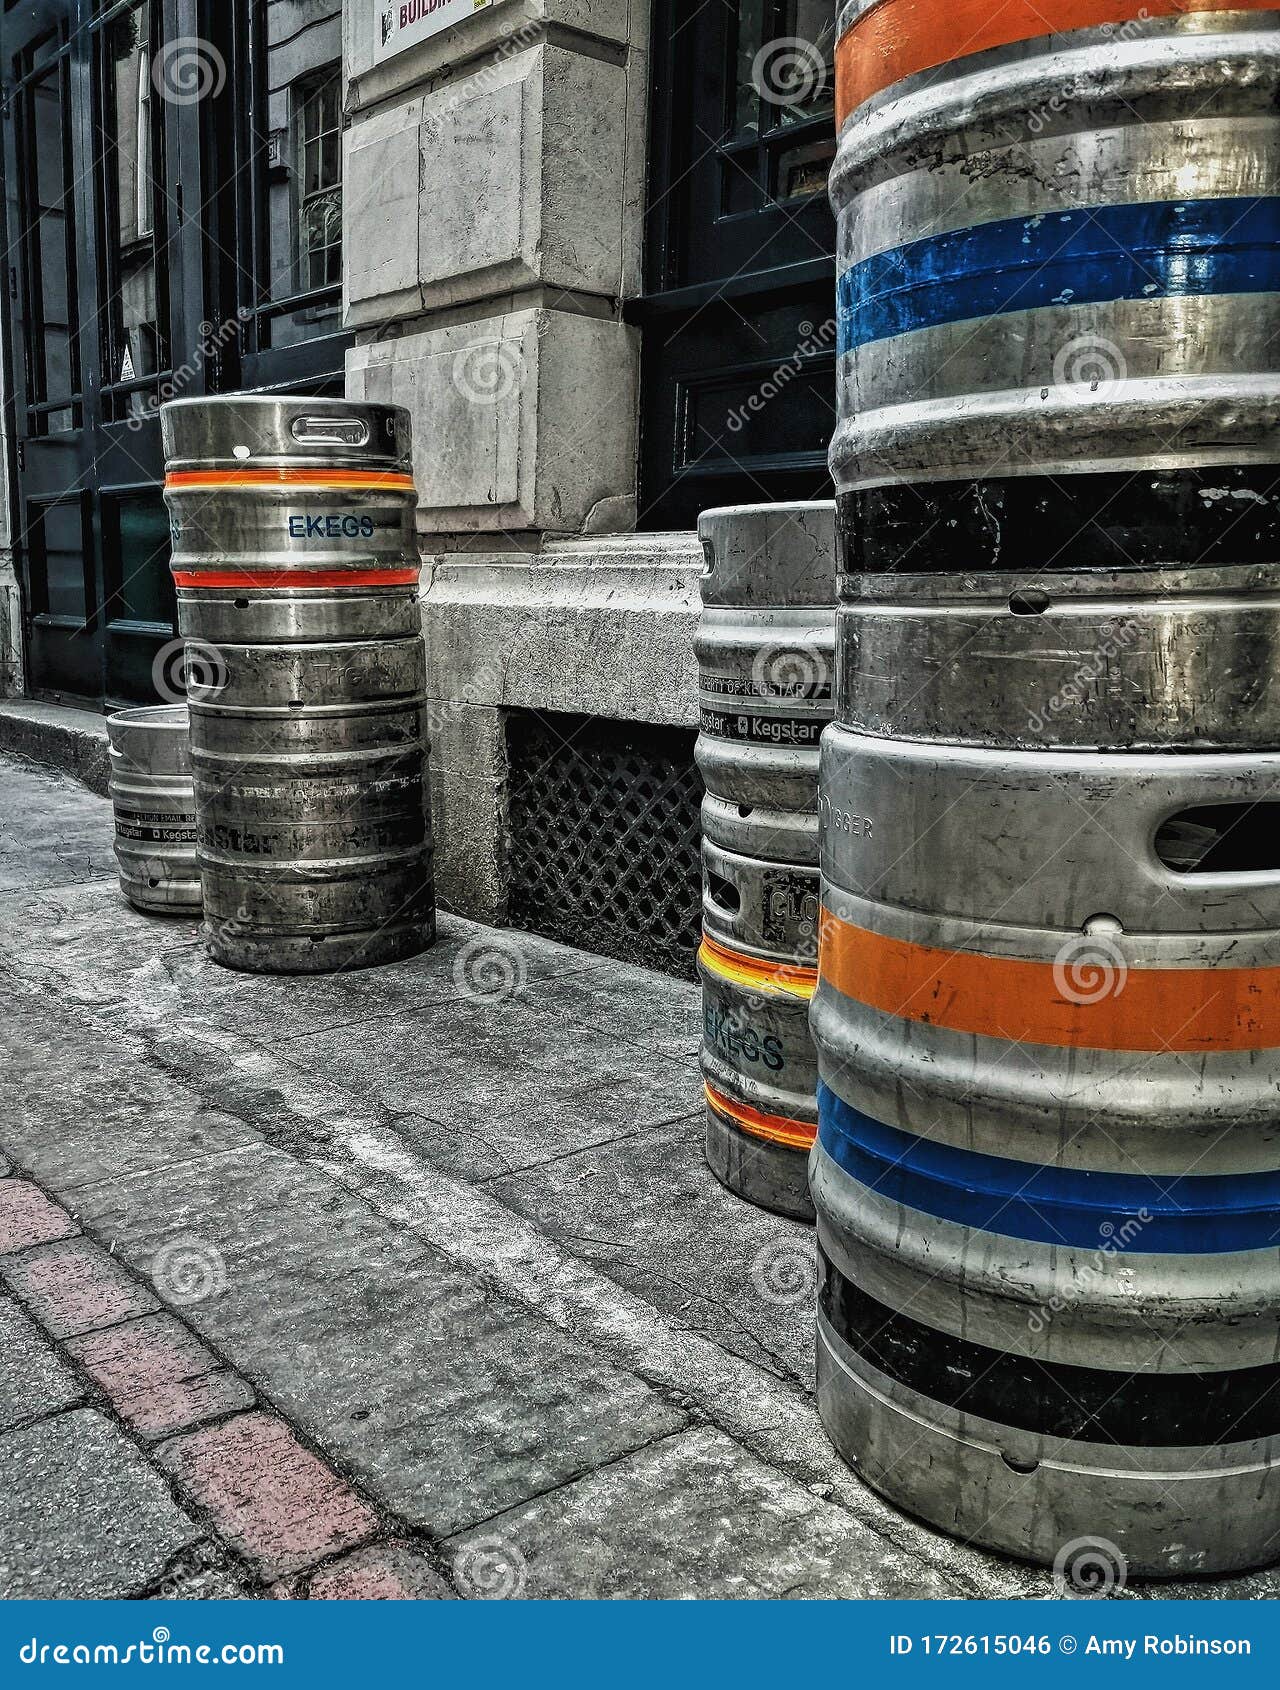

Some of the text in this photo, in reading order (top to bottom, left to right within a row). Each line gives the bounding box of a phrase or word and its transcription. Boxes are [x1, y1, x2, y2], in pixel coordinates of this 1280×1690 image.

[289, 515, 374, 538] EKEGS
[744, 679, 806, 698] KEGSTAR
[752, 716, 819, 741] Kegstar
[162, 829, 198, 842] Kegsta
[769, 890, 819, 922] CLO
